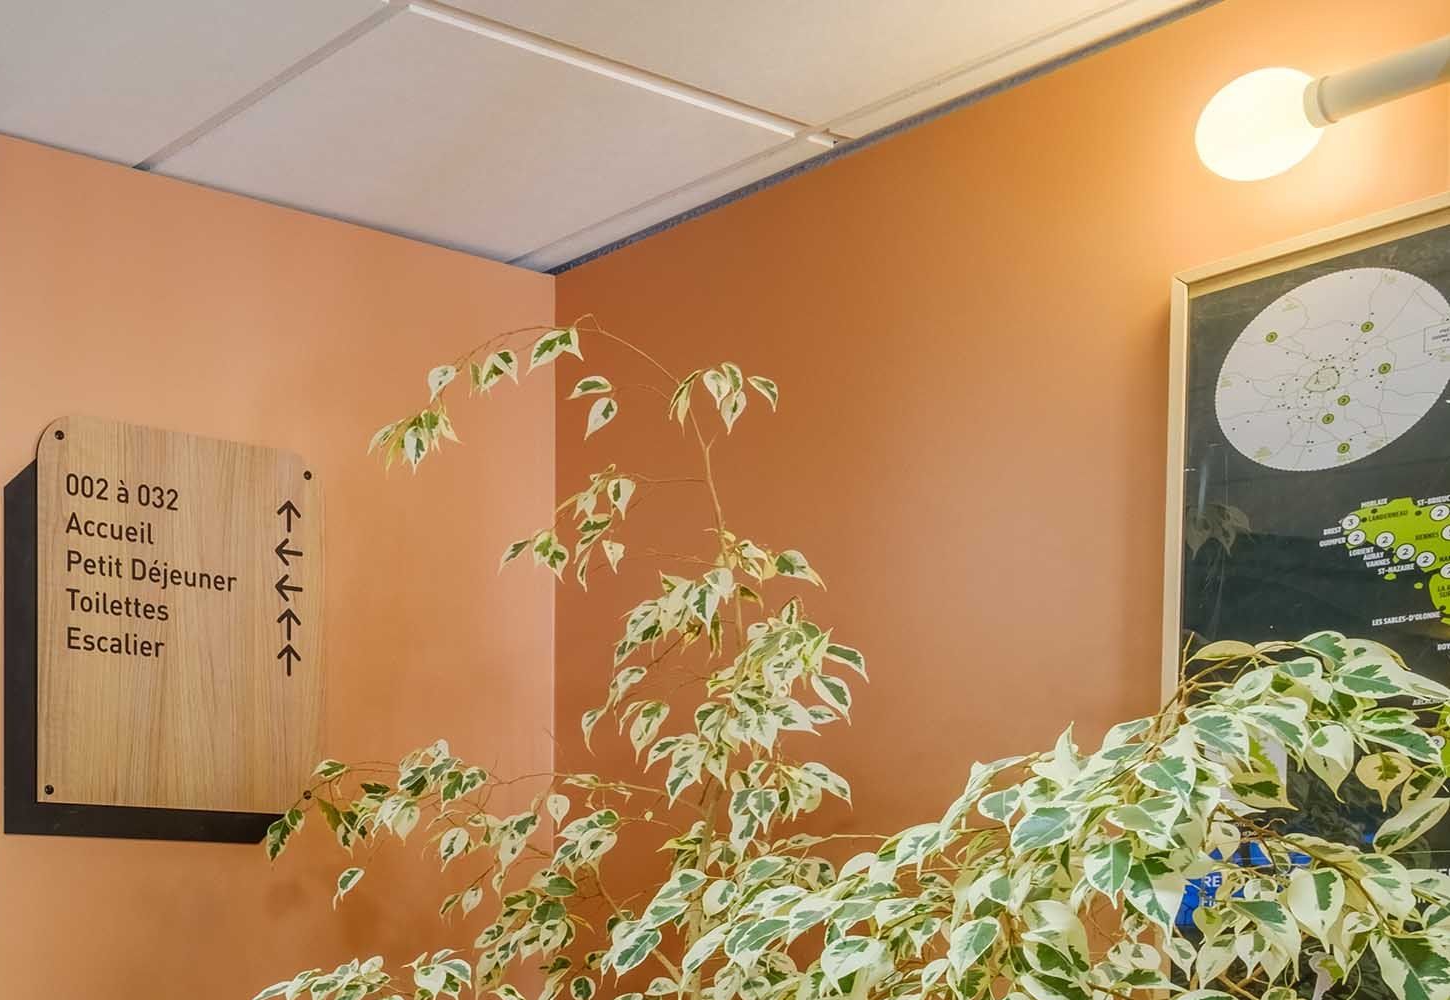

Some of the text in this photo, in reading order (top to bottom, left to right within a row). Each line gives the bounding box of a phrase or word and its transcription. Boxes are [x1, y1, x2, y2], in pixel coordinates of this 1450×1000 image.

[66, 473, 179, 510] 002 à 032
[66, 512, 154, 545] Accueil
[67, 550, 237, 592] Petit Déjeuner
[66, 588, 169, 621] Toilettes
[67, 626, 165, 657] Escalier
